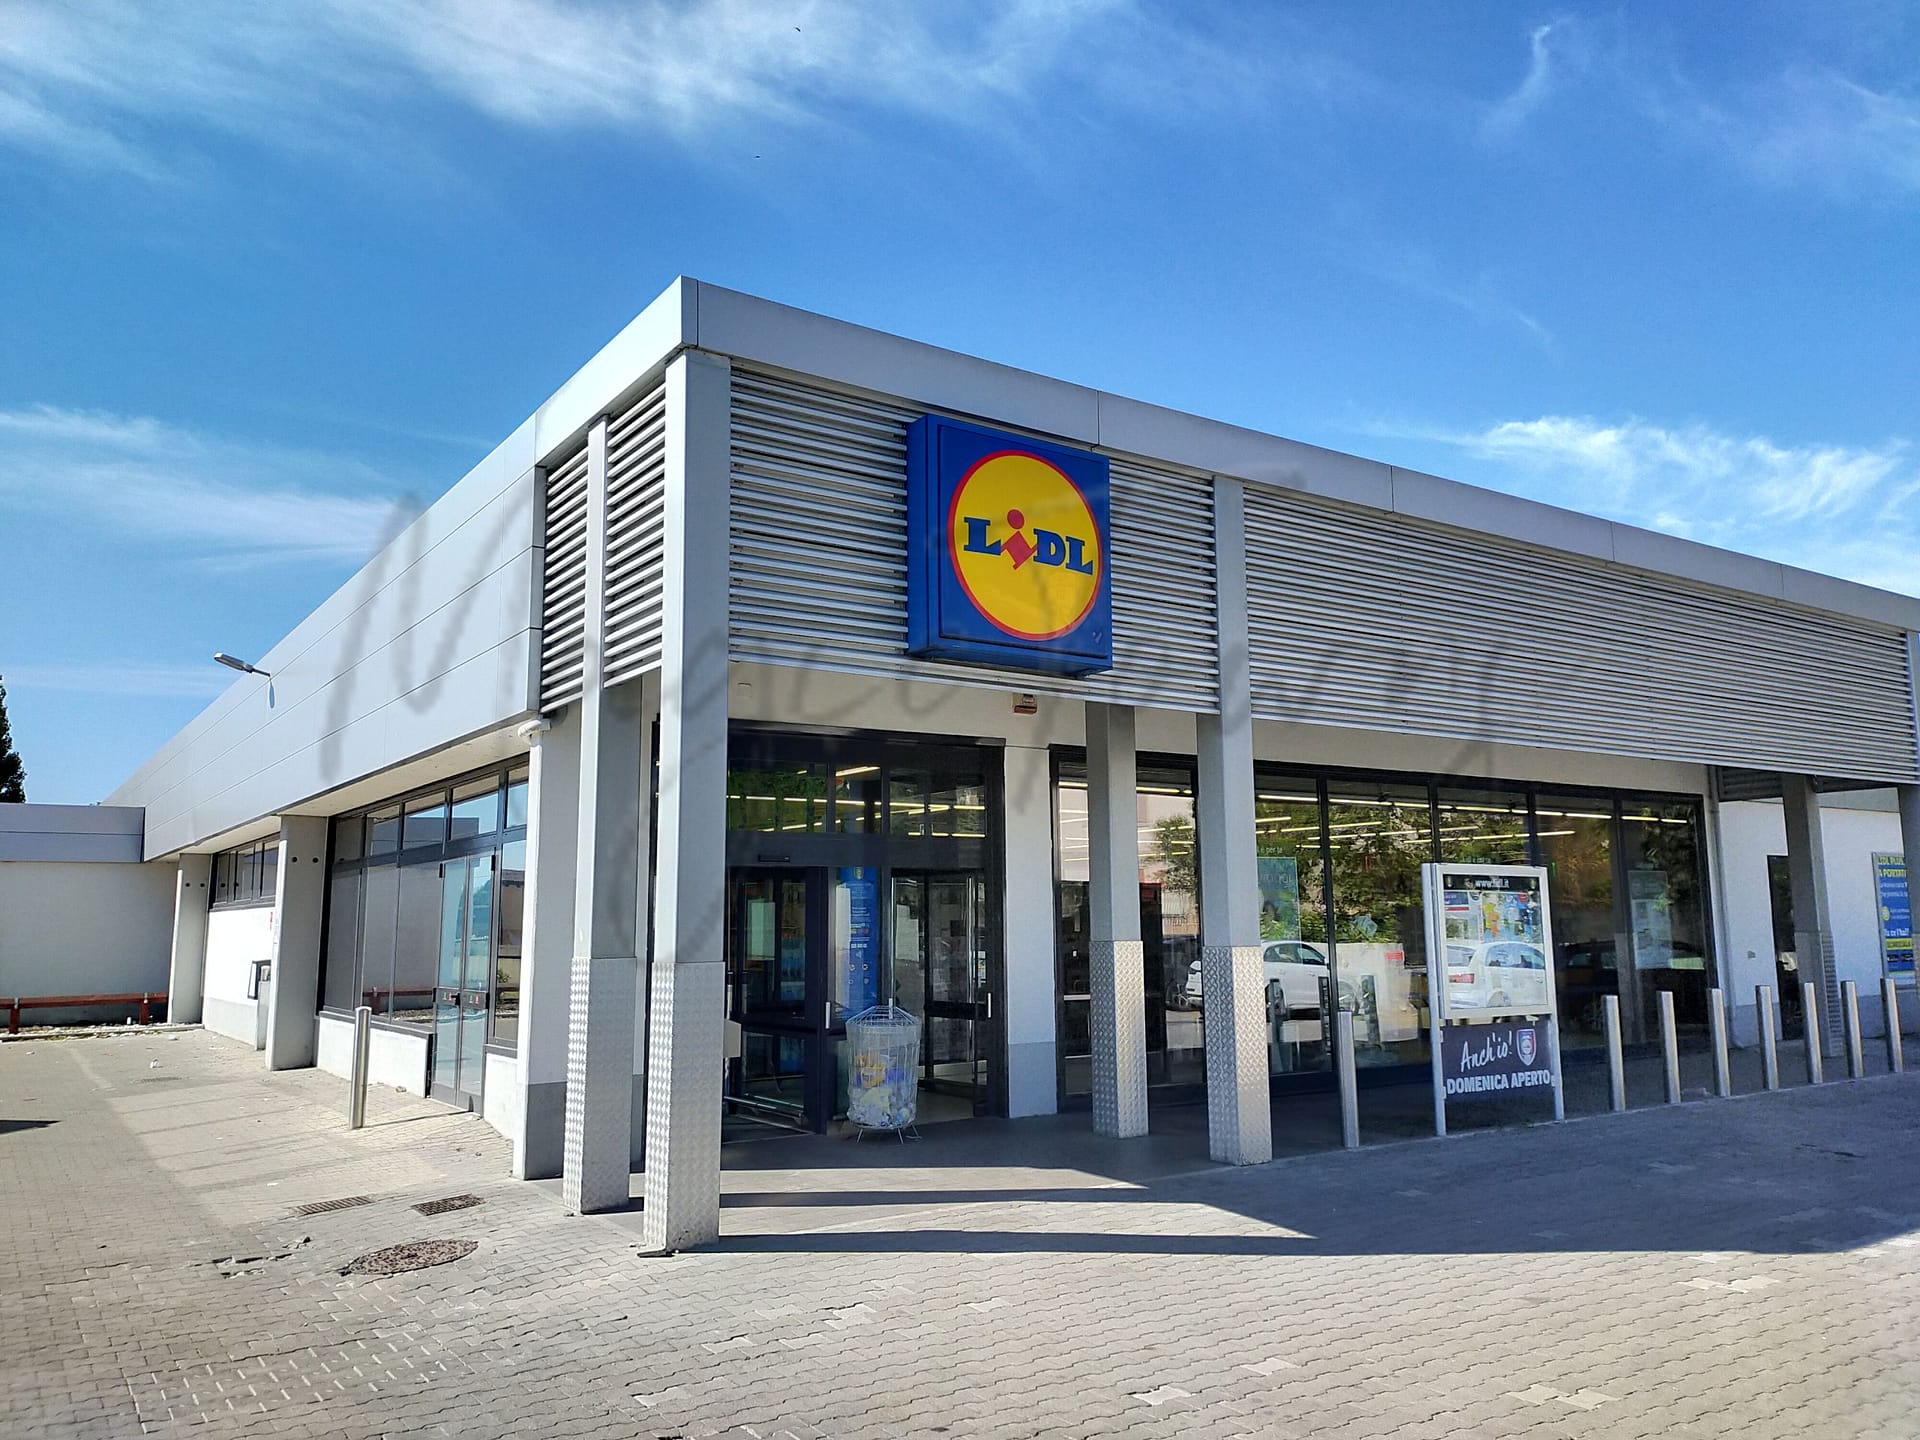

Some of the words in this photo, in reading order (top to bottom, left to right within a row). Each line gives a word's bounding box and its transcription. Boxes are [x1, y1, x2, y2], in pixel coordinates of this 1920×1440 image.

[1460, 1030, 1513, 1073] Anch'io!
[1447, 1073, 1509, 1095] DOMENICA
[1511, 1069, 1551, 1088] APERTO
